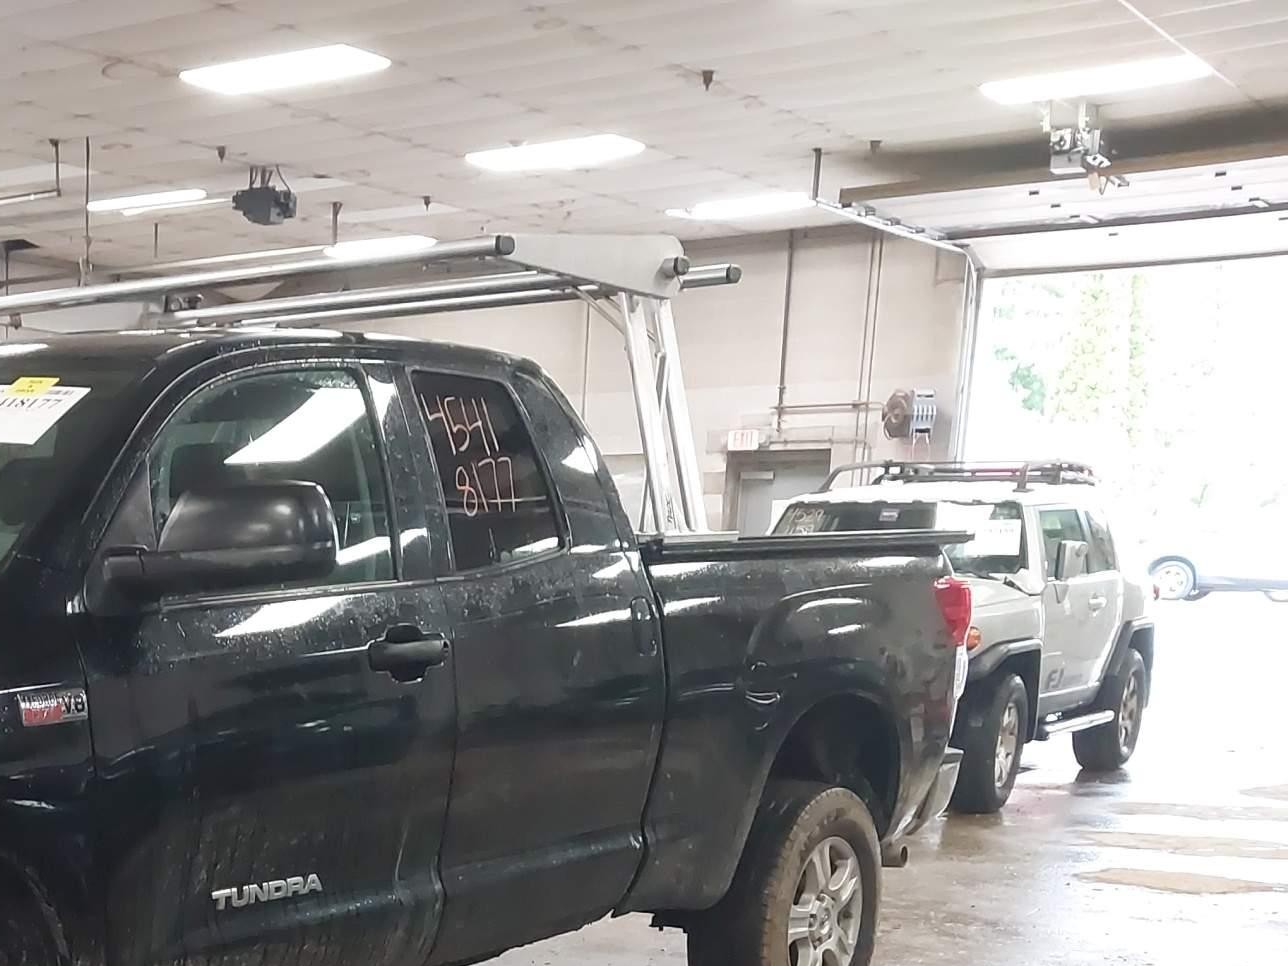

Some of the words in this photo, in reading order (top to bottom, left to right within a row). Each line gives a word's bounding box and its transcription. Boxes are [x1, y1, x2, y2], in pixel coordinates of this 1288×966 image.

[420, 393, 500, 456] 4541
[455, 456, 517, 518] 8177
[211, 873, 324, 911] TUNDRA
